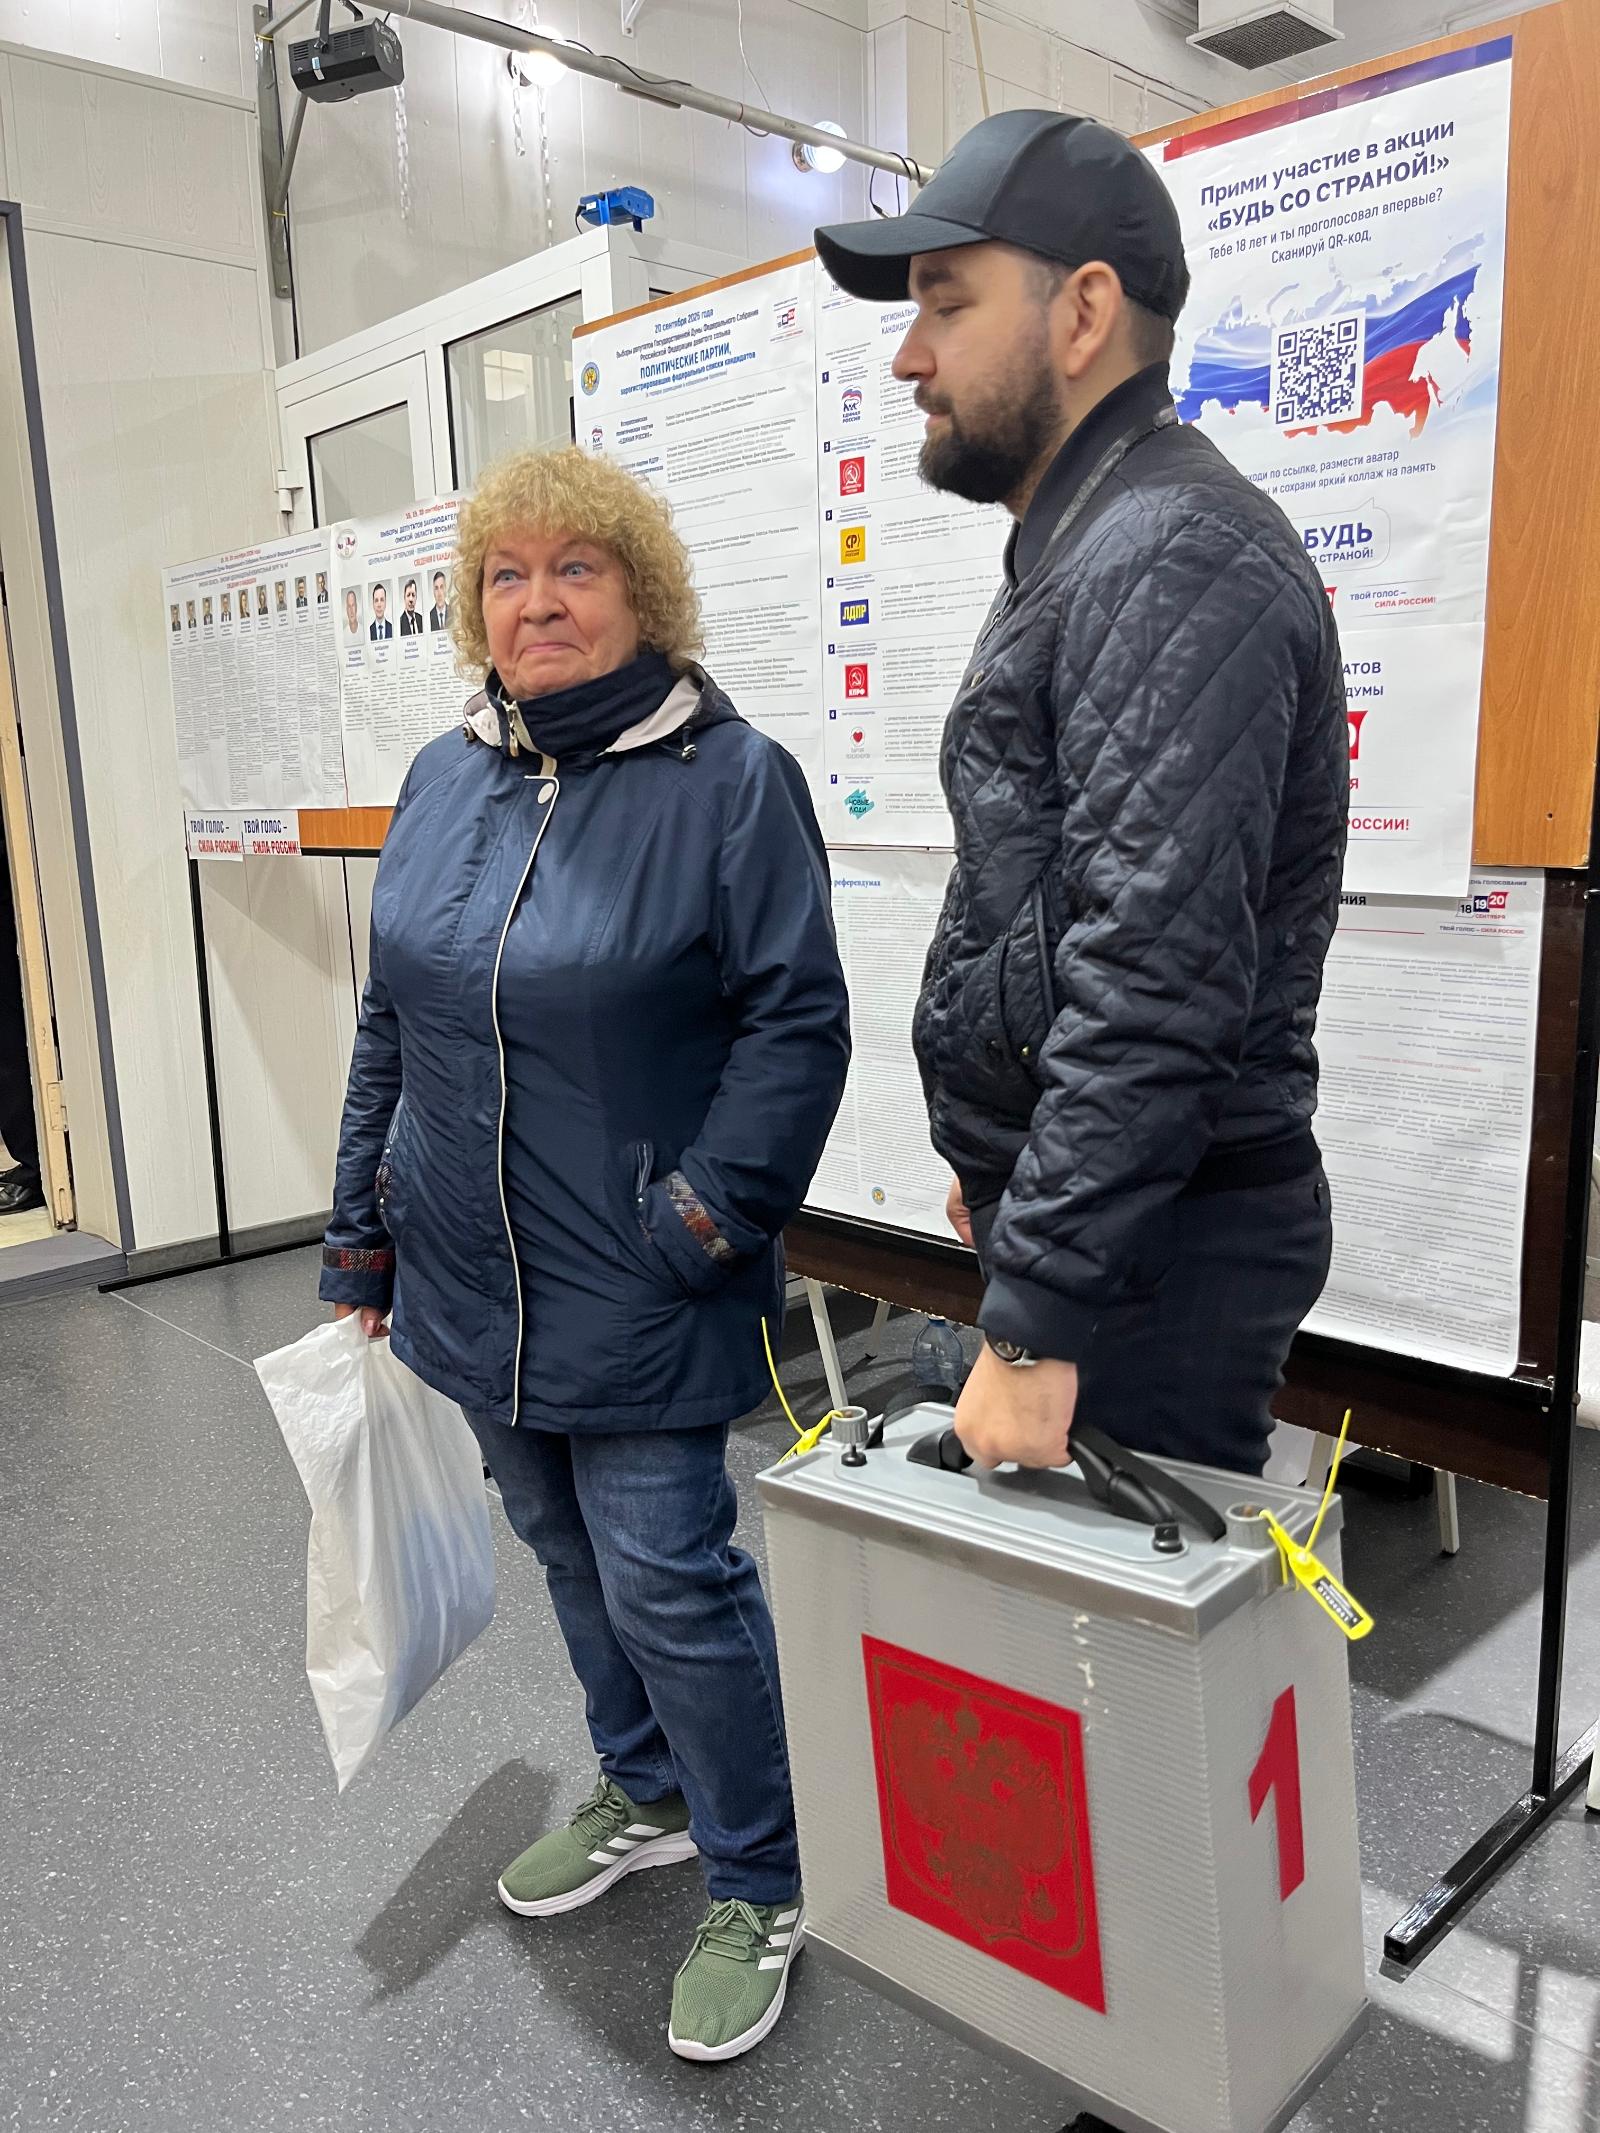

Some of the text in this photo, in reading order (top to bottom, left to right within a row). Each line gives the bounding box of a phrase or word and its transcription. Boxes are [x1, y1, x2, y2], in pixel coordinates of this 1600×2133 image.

[1201, 121, 1454, 207] Прими участие в акции
[1208, 150, 1450, 232] «БУДЬ СО СТРАНОЙ!»
[1209, 187, 1443, 260] Тебе 18 лет и ты проголосовал впервые?
[1271, 237, 1325, 264] Сканируй
[880, 306, 918, 324] РЕГИОНАЛЬН
[662, 317, 687, 331] сентября
[881, 320, 912, 335] КАНДИДАТ
[640, 342, 731, 379] ПОЛИТИЧЕСКИЕ ПАРТИИ,
[1243, 450, 1399, 483] ходи по ссылке, размести аватар
[1272, 485, 1278, 494] и
[1280, 480, 1316, 493] сохрани
[1318, 473, 1345, 488] яркий
[1348, 467, 1383, 483] коллаж
[1386, 467, 1398, 476] на
[1400, 462, 1436, 475] память
[434, 523, 457, 533] ВОСЬМО
[1303, 521, 1373, 550] БУДЬ
[1319, 547, 1373, 564] СТРАНОЙ!
[1350, 590, 1371, 600] ТВОЙ
[1372, 589, 1399, 599] ГОЛОС
[1374, 597, 1436, 608] СИЛА РОССИИ!
[843, 605, 867, 621] ЛДПР
[1343, 662, 1381, 675] АТОВ
[849, 689, 865, 697] КПРФ
[1345, 686, 1384, 698] ДУМЫ
[191, 818, 204, 833] ТВОЙ
[205, 820, 225, 834] ГОЛОС
[244, 818, 259, 833] ТВОЙ
[261, 820, 281, 833] ГОЛОС
[198, 840, 214, 853] СИЛА
[253, 841, 299, 854] СИЛА РОССИИ!
[1340, 895, 1366, 905] НИЯ
[1460, 895, 1505, 914] 18 19 20
[1248, 1684, 1305, 1903] 1
